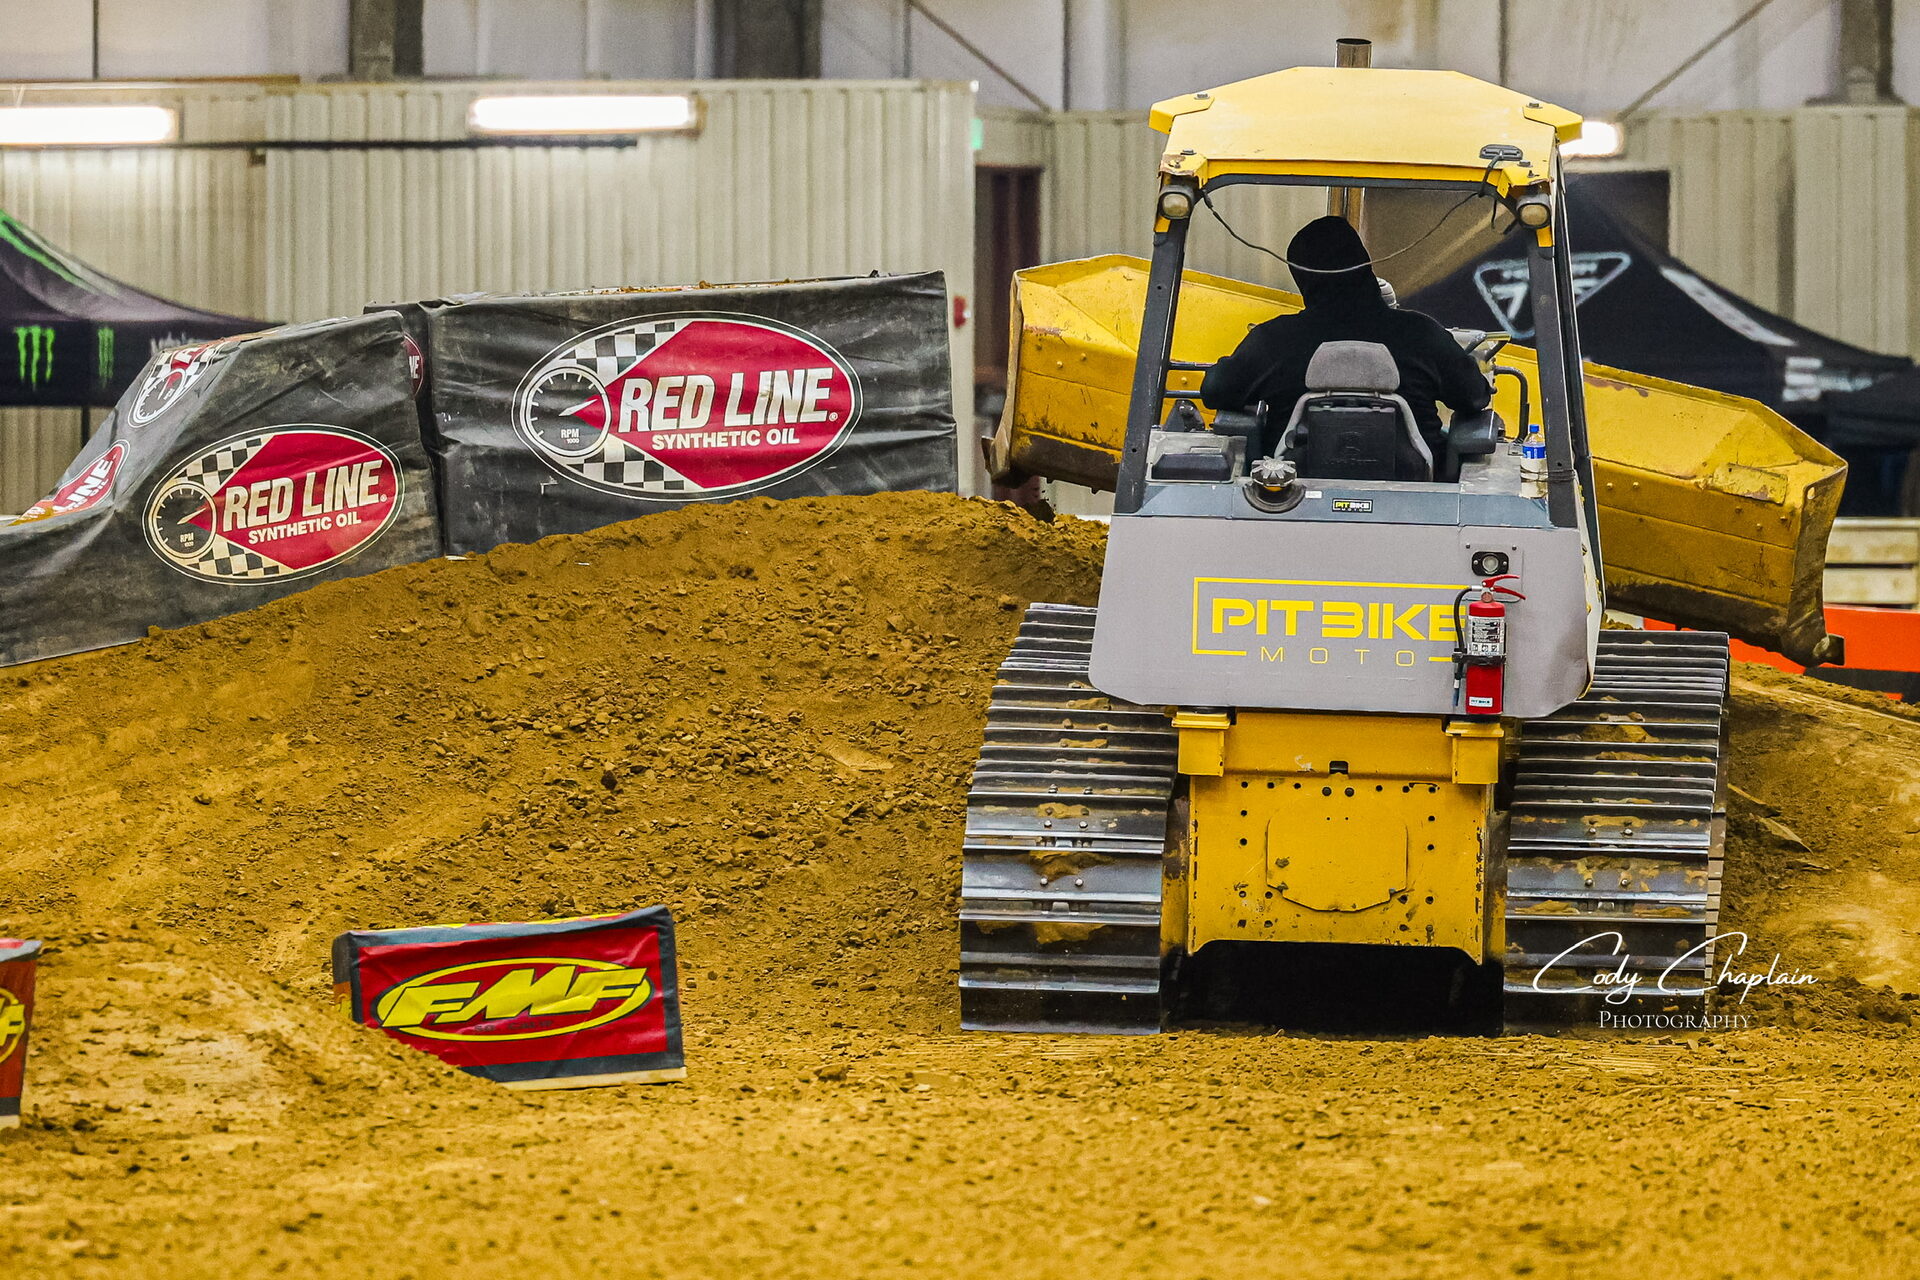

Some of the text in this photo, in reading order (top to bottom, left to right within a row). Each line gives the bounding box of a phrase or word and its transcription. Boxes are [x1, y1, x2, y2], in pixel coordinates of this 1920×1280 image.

[618, 367, 834, 433] RED LINE
[561, 428, 579, 439] RPM
[652, 428, 799, 450] SYNTHETIC OIL
[223, 459, 383, 532] RED LINE
[180, 532, 194, 543] RPM
[248, 511, 362, 545] SYNTHETIC OIL
[1260, 646, 1415, 667] MOTO
[382, 965, 648, 1028] FMF
